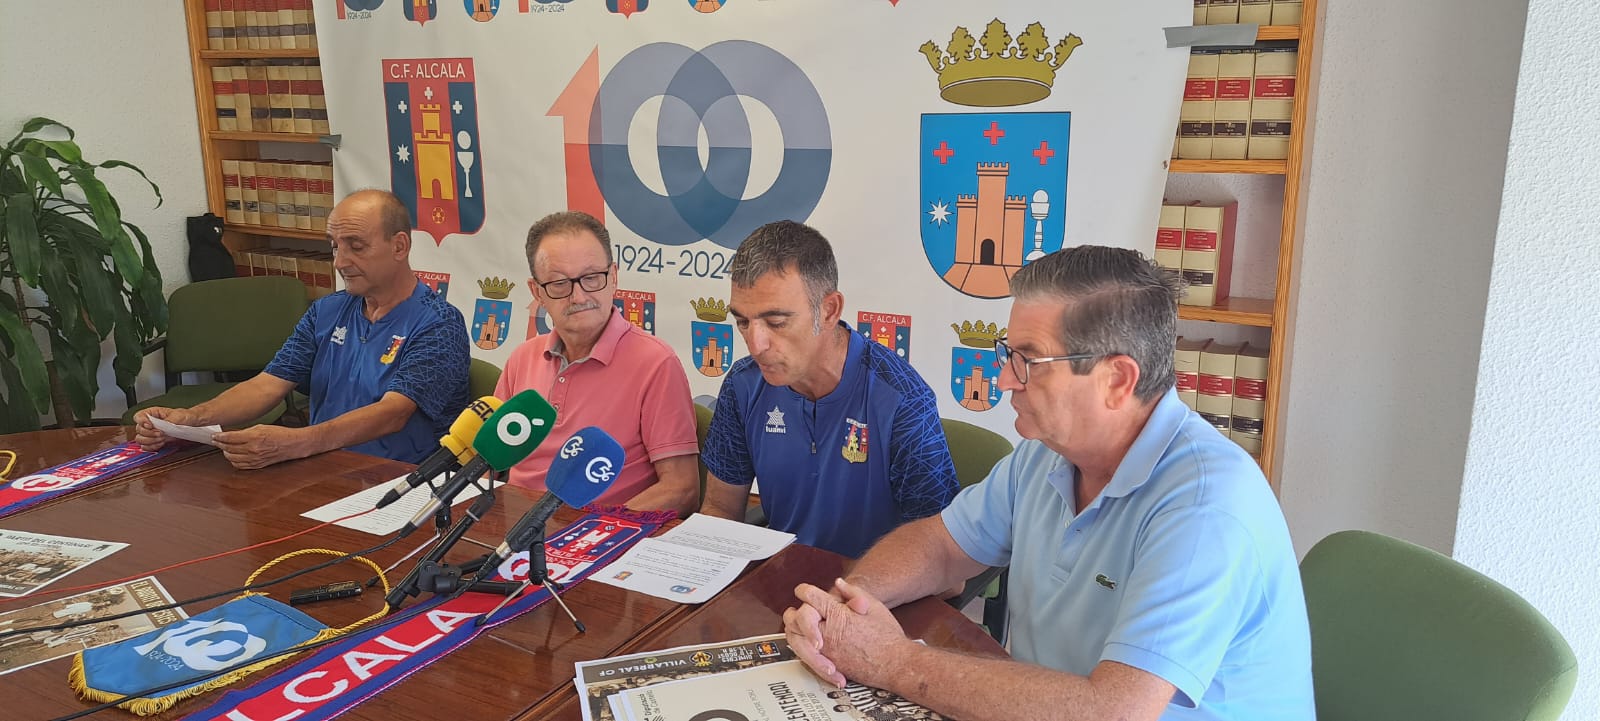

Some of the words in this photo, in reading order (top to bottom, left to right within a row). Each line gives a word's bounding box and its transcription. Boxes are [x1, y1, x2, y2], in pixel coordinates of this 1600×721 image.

[531, 4, 565, 13] 1924-2024
[347, 11, 372, 20] 1924-2024
[390, 63, 414, 79] C.F.
[416, 62, 466, 79] ALCALA
[628, 293, 652, 301] ALCALA
[862, 313, 875, 322] C.F.
[877, 315, 907, 325] ALCALA
[619, 659, 687, 674] VILLARREAL
[600, 669, 616, 677] CF
